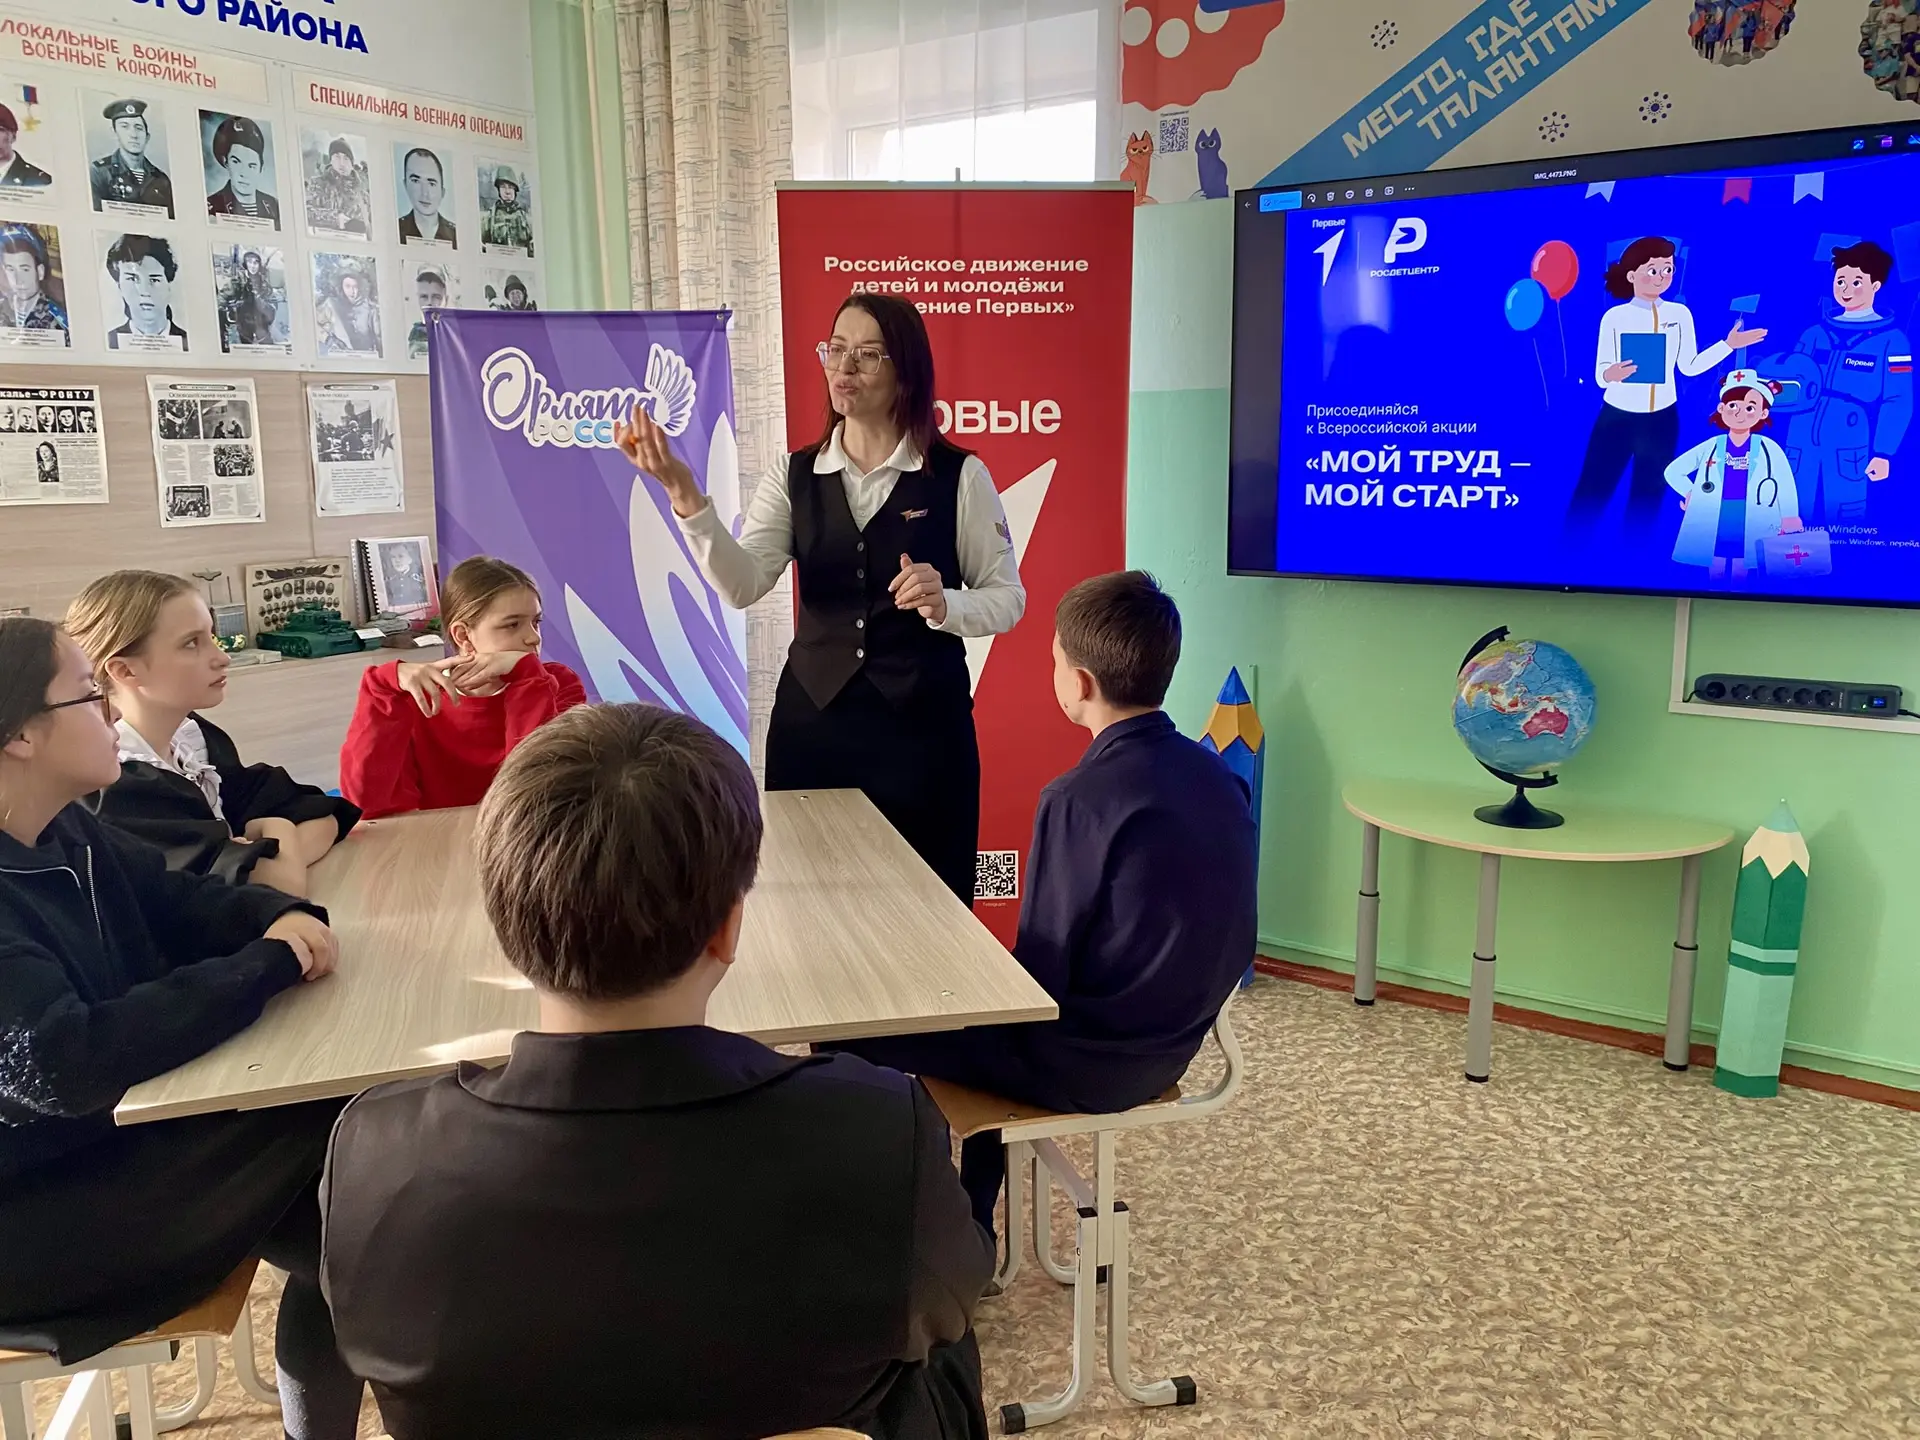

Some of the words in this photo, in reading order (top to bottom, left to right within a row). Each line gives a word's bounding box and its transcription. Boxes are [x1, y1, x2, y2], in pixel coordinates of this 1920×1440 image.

[217, 0, 369, 54] РАЙОНА
[0, 19, 120, 54] ЛОКАЛЬНЫЕ
[133, 43, 197, 70] ВОЙНЫ
[22, 39, 107, 68] ВОЕННЫЕ
[117, 57, 217, 89] КОНФЛИКТЫ
[1342, 56, 1467, 159] МЕСТО,
[1465, 0, 1539, 62] ГДЕ
[310, 83, 408, 119] СПЕЦИАЛЬНАЯ
[414, 105, 466, 130] ВОЕННАЯ
[469, 116, 524, 141] ОПЕРАЦИЯ
[1312, 218, 1346, 230] Первые
[824, 256, 966, 272] Российское
[970, 258, 1089, 274] движение
[1370, 266, 1440, 278] РОСДЕТЦЕНТР
[850, 277, 919, 295] детей
[924, 281, 938, 293] и
[943, 277, 1064, 295] молодёжи
[976, 298, 1075, 317] Первых»
[1307, 403, 1419, 419] Присоединяйся
[532, 418, 622, 443] РОСС
[1306, 424, 1314, 434] к
[1318, 421, 1428, 436] Всероссийской
[1431, 422, 1477, 435] акции
[1306, 444, 1402, 473] «МОЙ
[1409, 450, 1502, 478] ТРУД
[1305, 479, 1385, 507] МОЙ
[1392, 484, 1520, 509] СТАРТ»
[1828, 524, 1878, 535] Windows
